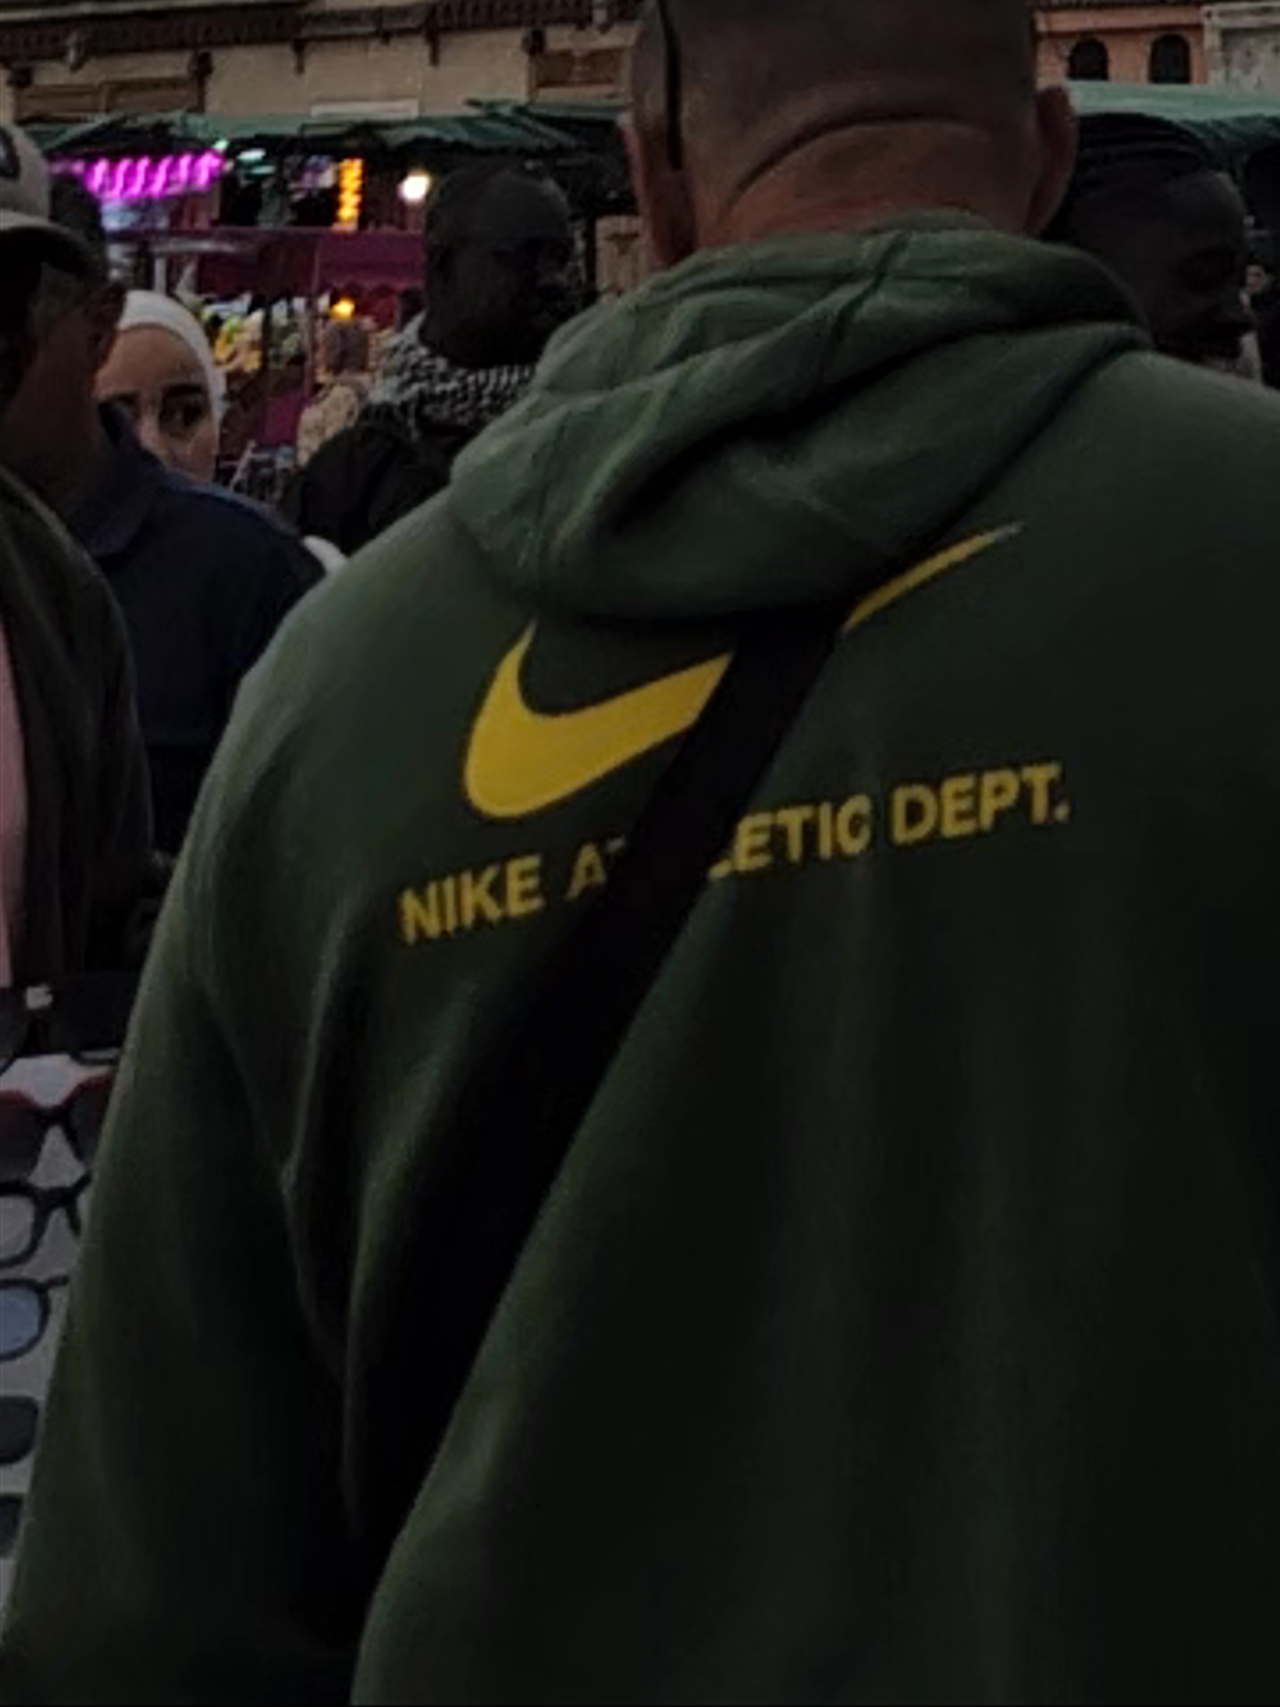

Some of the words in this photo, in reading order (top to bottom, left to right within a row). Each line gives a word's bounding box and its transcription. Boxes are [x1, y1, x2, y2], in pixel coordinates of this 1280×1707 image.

[398, 852, 547, 946] NIKE
[564, 792, 873, 901] AETIC
[890, 759, 1072, 847] DEPT.
